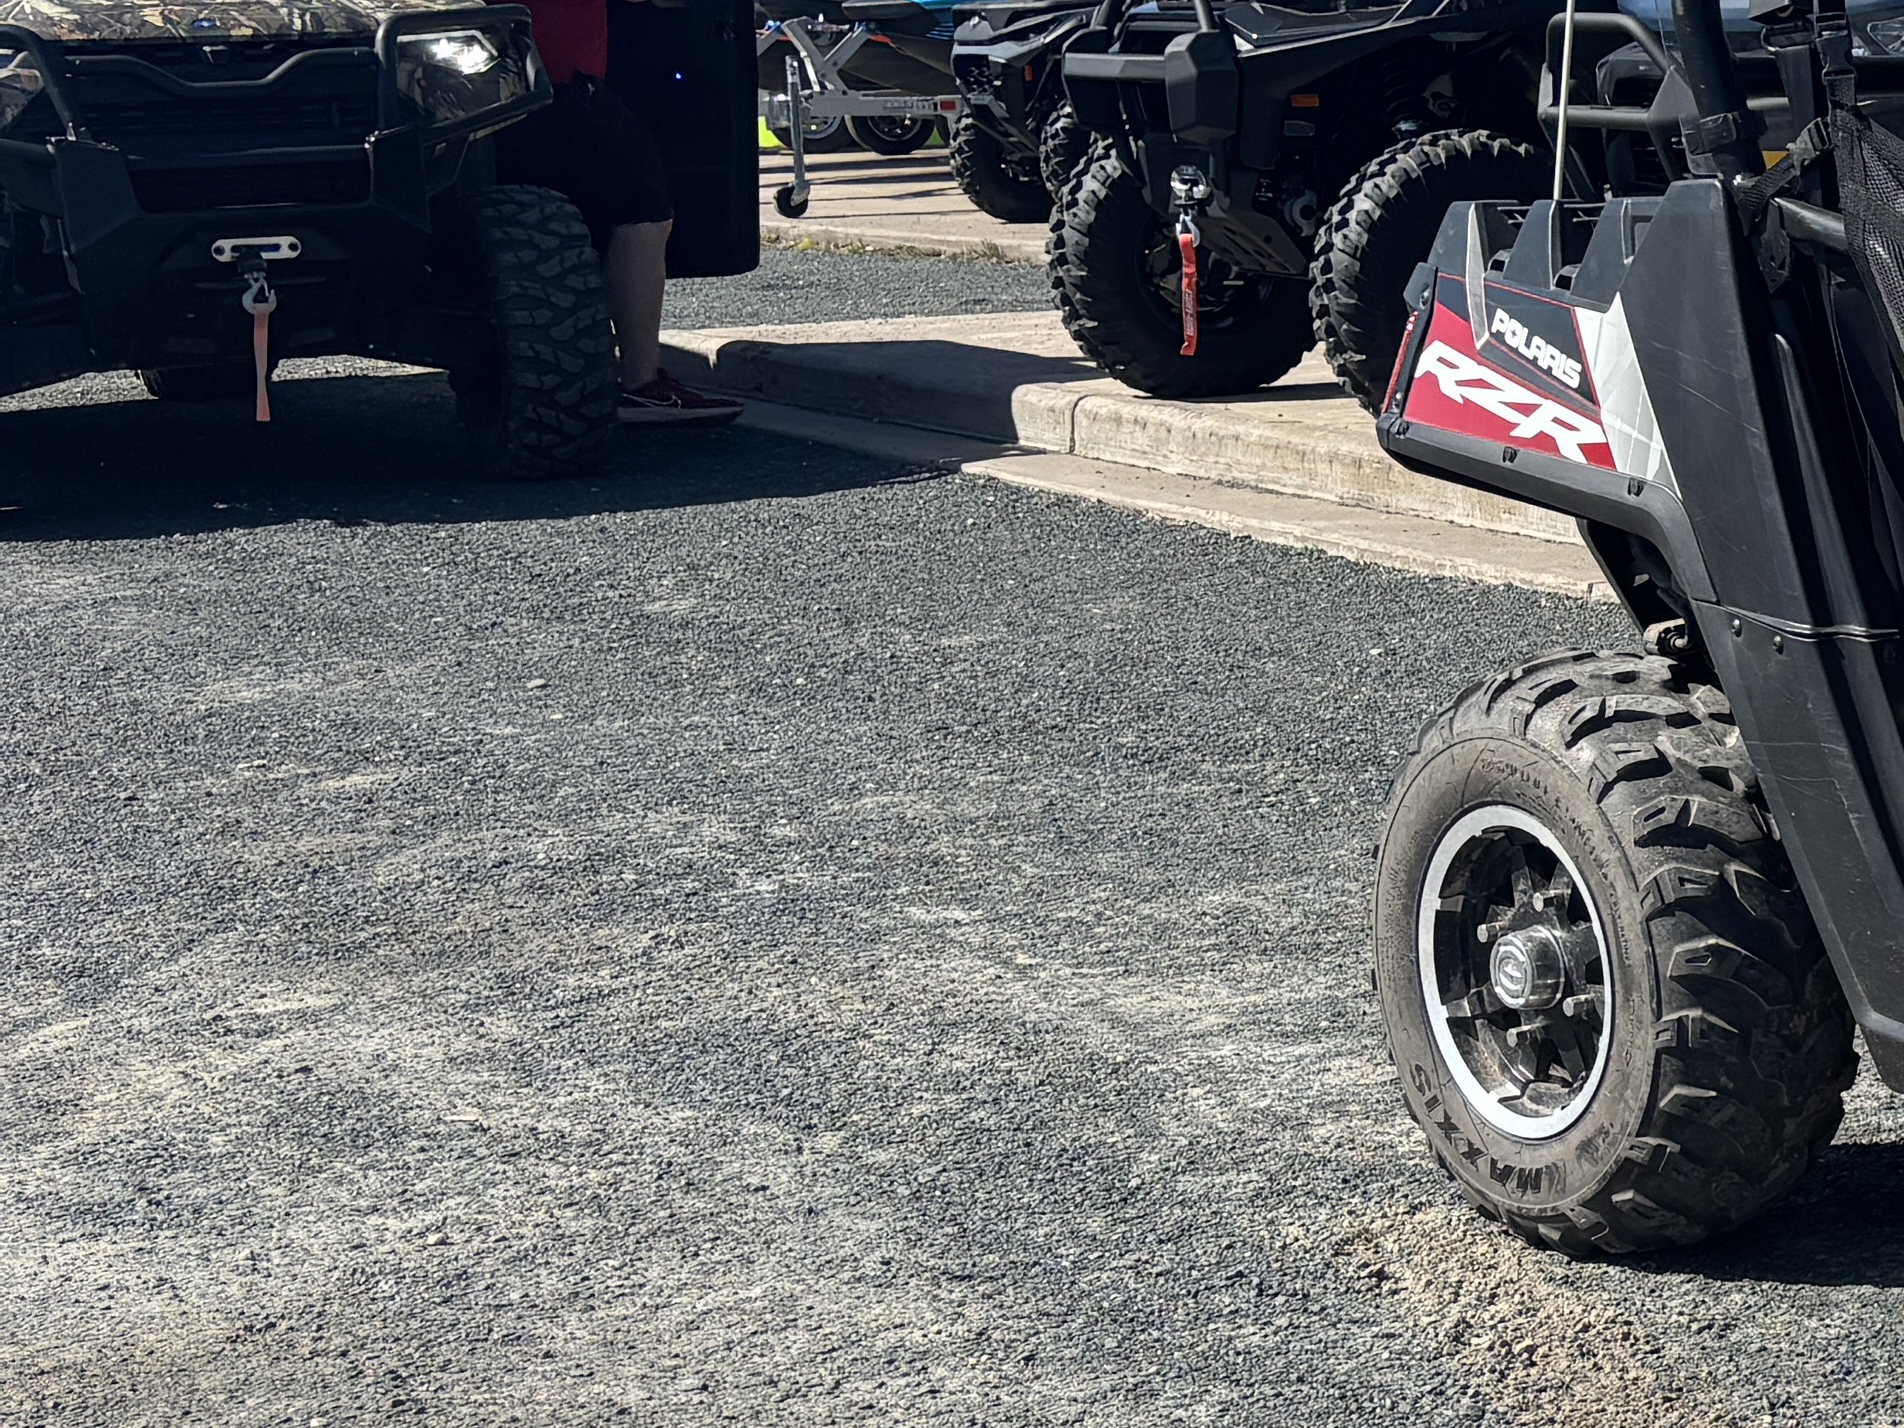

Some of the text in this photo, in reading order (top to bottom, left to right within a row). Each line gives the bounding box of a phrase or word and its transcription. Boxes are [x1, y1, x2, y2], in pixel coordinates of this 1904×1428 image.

[1414, 340, 1608, 464] RZR
[1490, 307, 1582, 389] POLARIS
[1410, 1062, 1544, 1195] MAXXIS
